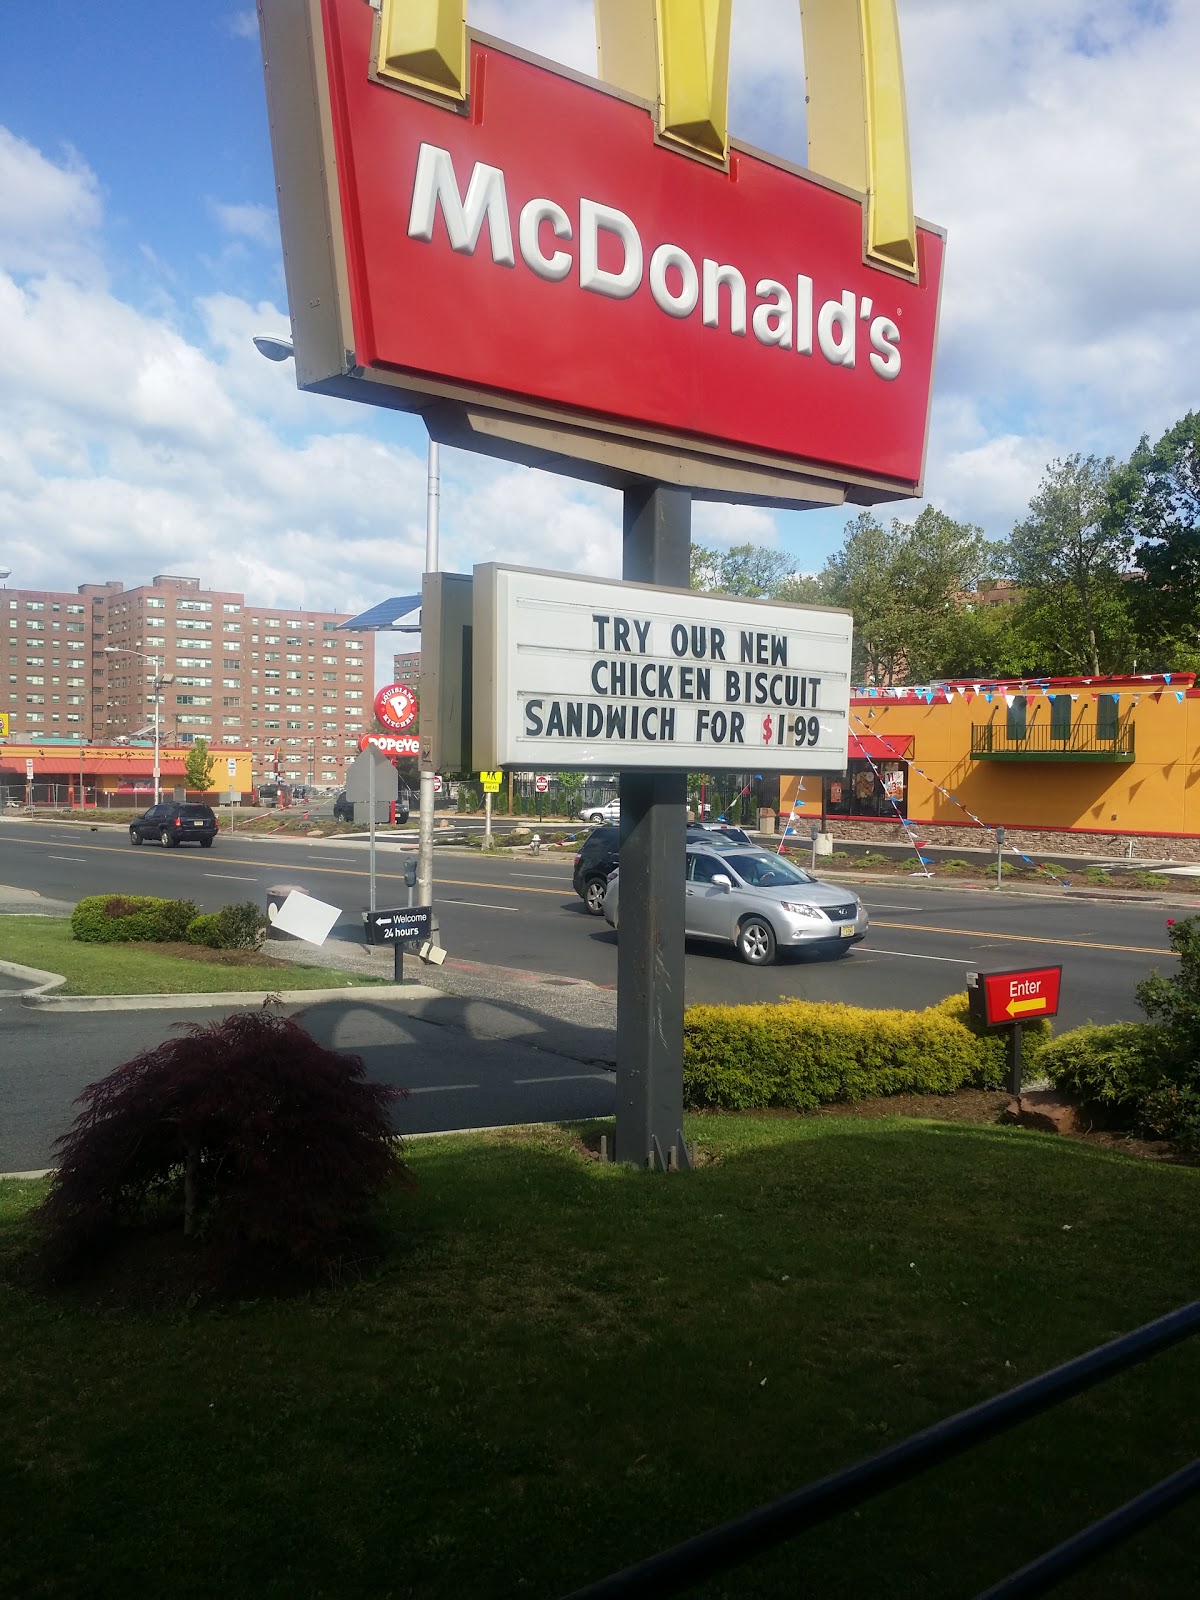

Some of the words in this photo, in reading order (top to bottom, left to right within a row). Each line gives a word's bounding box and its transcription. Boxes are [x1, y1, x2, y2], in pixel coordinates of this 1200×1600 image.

[407, 142, 902, 381] McDonald's
[592, 615, 651, 653] TRY
[671, 624, 726, 660] OUR
[740, 631, 788, 667] NEW
[591, 660, 711, 700] CHICKEN
[726, 670, 821, 707] BISCUIT
[381, 687, 415, 705] LOUISIANA
[382, 713, 415, 728] KITCHEN
[525, 700, 675, 740] SANDWICH
[696, 709, 745, 743] FOR
[393, 914, 426, 923] Welcome
[384, 928, 394, 938] 24
[395, 927, 419, 937] hours
[1010, 980, 1041, 997] Enter
